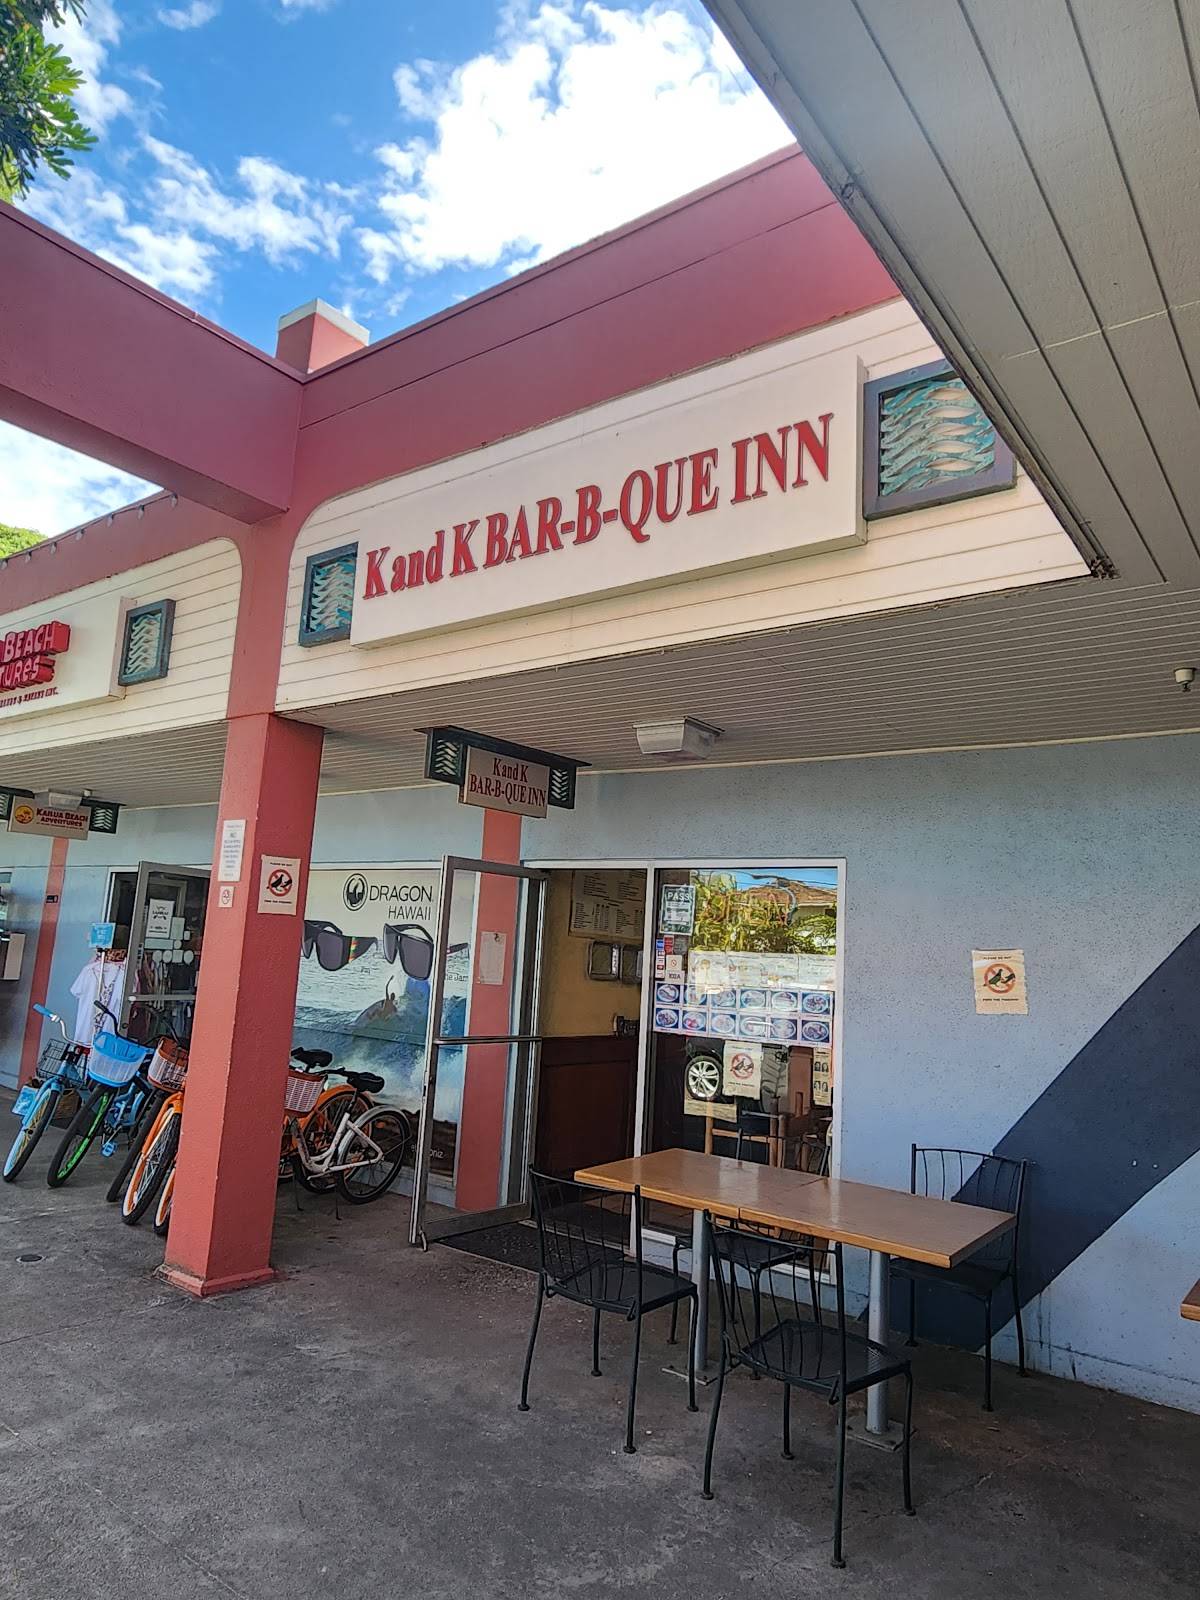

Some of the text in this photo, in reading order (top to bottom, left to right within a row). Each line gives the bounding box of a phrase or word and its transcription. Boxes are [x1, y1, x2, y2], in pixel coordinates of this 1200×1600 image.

[362, 412, 834, 600] K and K BAR-B-QUE INN
[3, 621, 62, 663] BEACH
[493, 757, 529, 783] K and K
[469, 773, 547, 808] BAR-B-QUE INN
[36, 807, 64, 818] KAILUA
[369, 885, 433, 902] DRAGON
[667, 891, 690, 901] PASS
[388, 905, 432, 921] HAWAII
